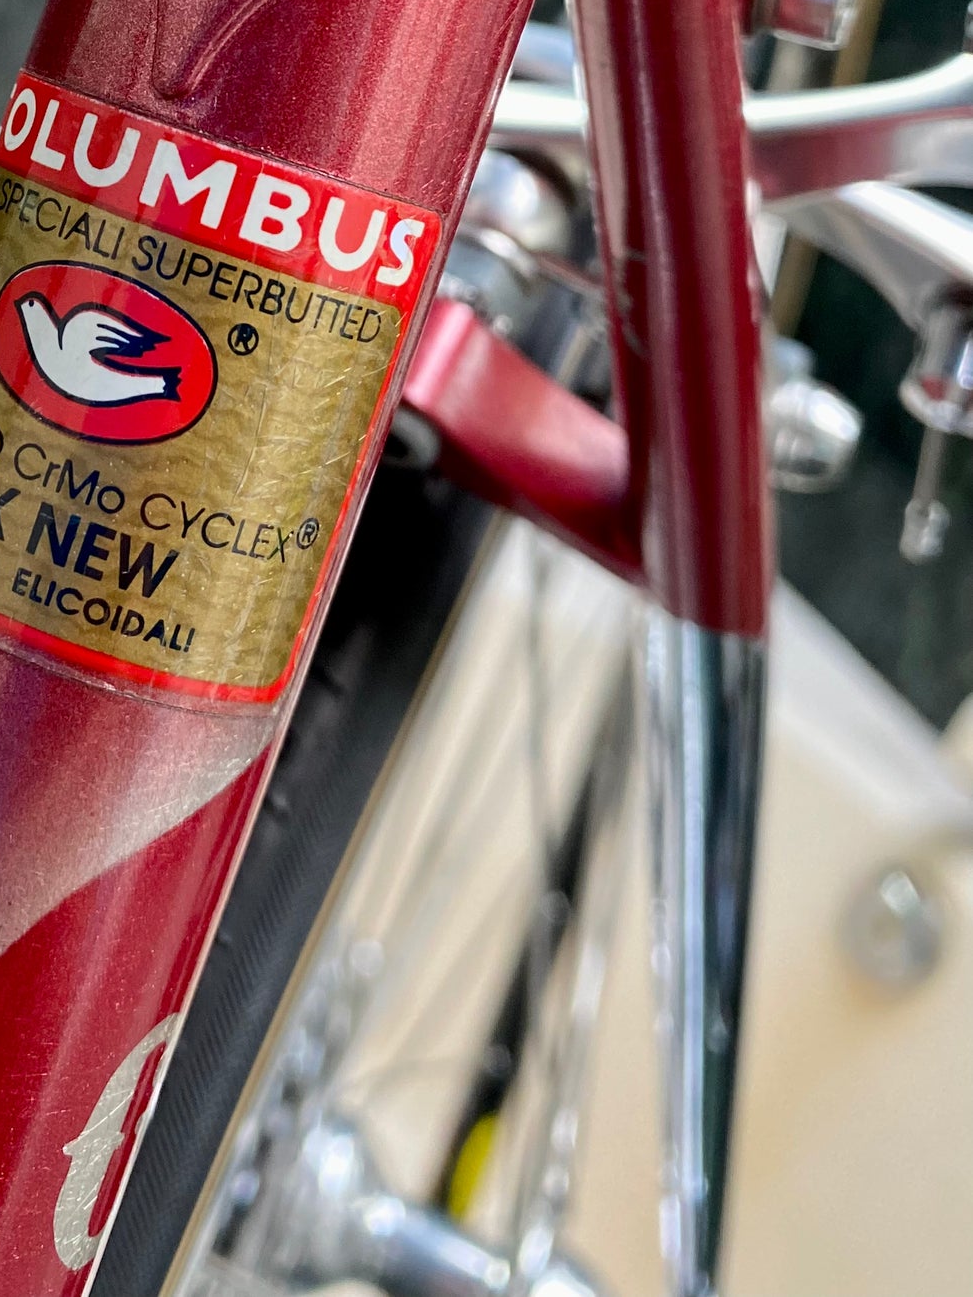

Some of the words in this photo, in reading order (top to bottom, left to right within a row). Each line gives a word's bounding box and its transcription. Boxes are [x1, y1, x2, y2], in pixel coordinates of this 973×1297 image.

[132, 235, 381, 343] SUPERBUTTED
[13, 443, 125, 514] CrMo
[26, 502, 180, 599] NEW
[11, 567, 196, 653] ELICOIDALI
